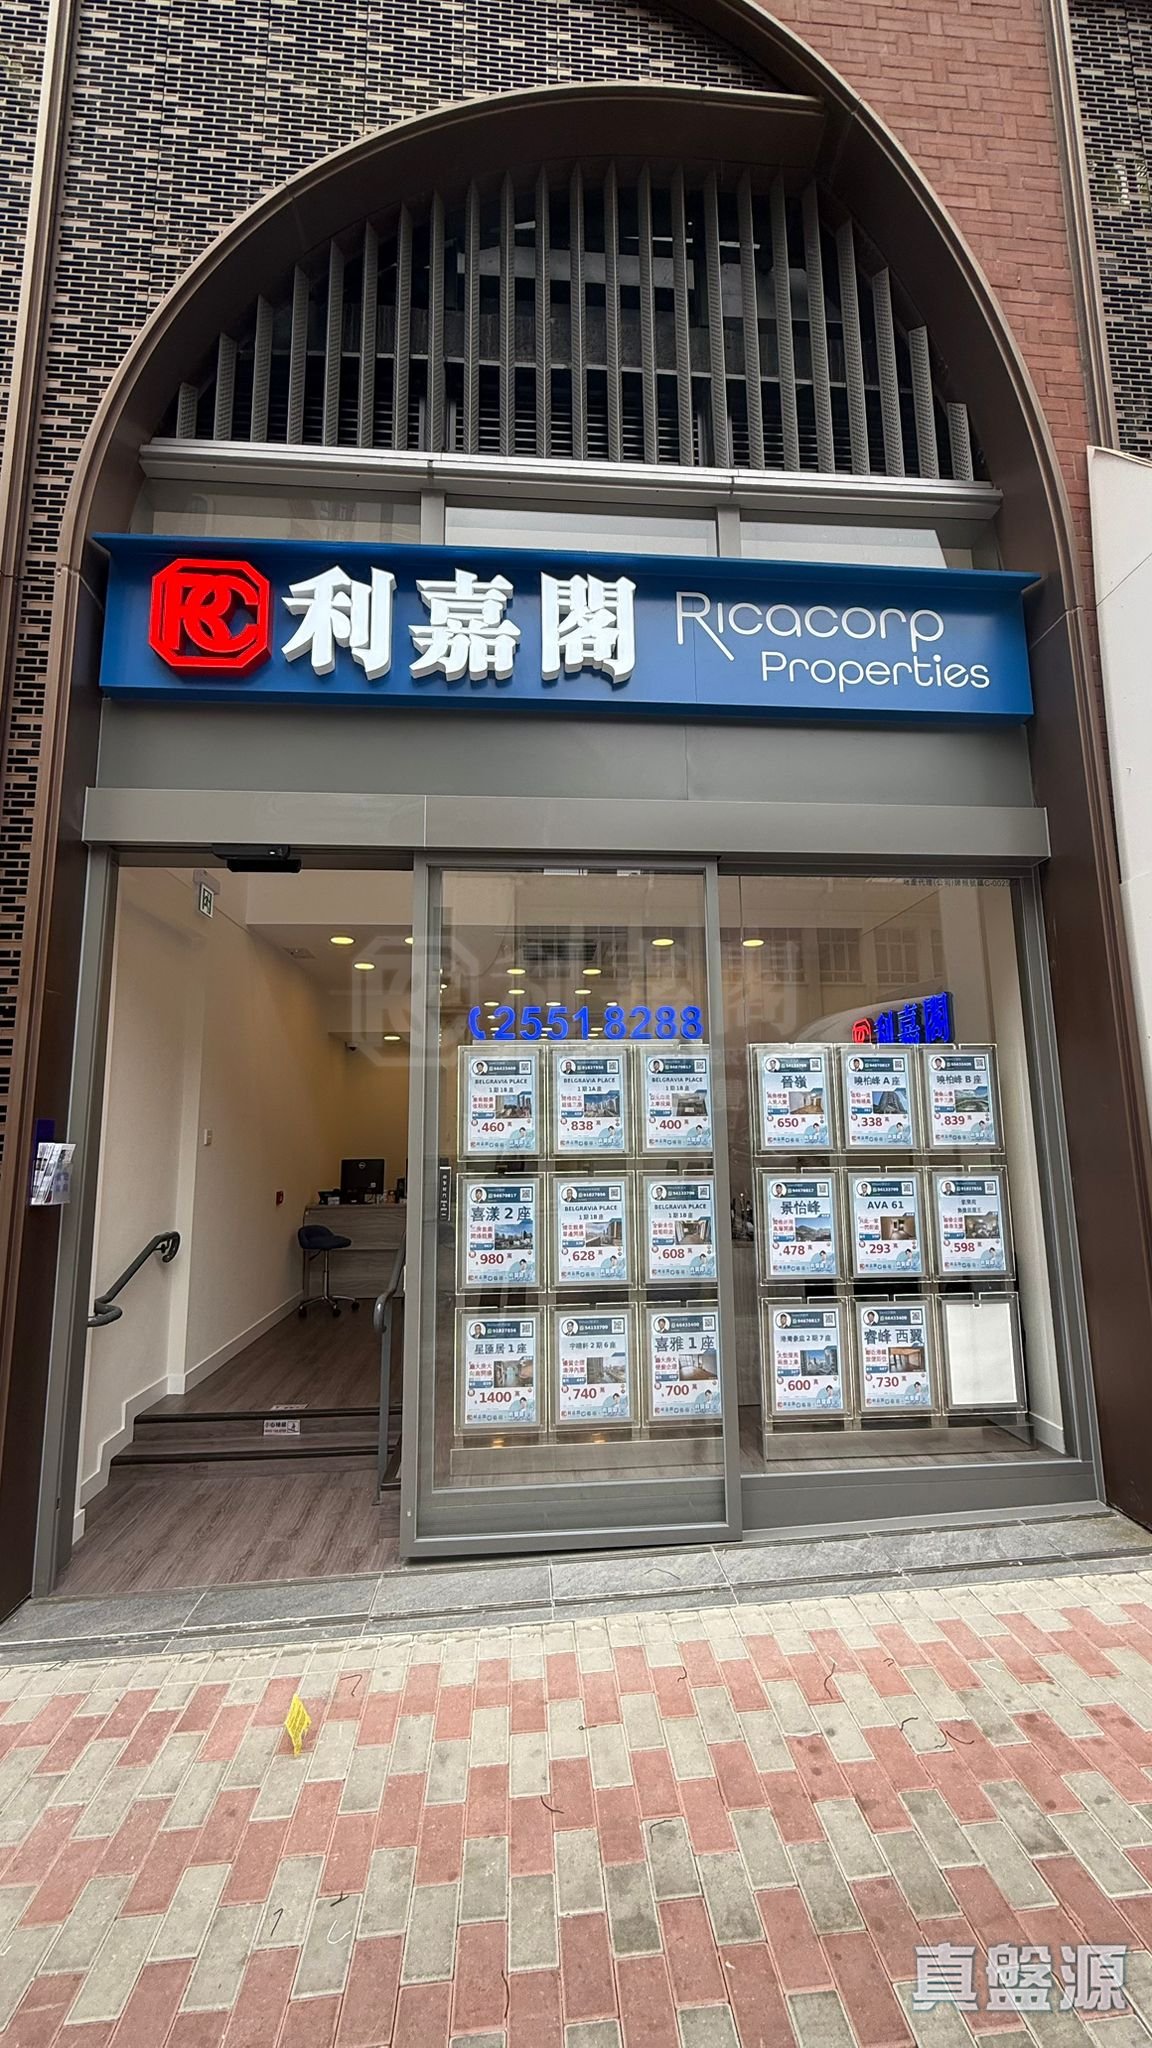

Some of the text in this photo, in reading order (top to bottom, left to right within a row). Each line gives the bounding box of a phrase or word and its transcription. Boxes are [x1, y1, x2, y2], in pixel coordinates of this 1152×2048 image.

[281, 565, 637, 685] 利嘉閣
[676, 591, 945, 661] Ricacorp
[761, 651, 990, 692] Properties
[494, 1005, 703, 1040] 2551 8288
[571, 1120, 593, 1131] 838
[659, 1119, 682, 1130] 400
[777, 1118, 799, 1128] 650
[861, 1117, 883, 1127] 338
[944, 1115, 965, 1125] 839
[481, 1122, 505, 1132] 460
[780, 1200, 821, 1215] 景怡峰
[867, 1200, 904, 1209] AVA 61
[783, 1245, 805, 1256] 478
[869, 1243, 891, 1254] 293
[954, 1242, 975, 1253] 598
[480, 1253, 504, 1265] 980
[572, 1250, 595, 1261] 628
[662, 1248, 685, 1259] 608
[787, 1379, 811, 1391] 600
[876, 1376, 899, 1388] 730
[572, 1387, 597, 1400] 740
[665, 1384, 689, 1396] 700
[479, 1391, 512, 1403] 1400
